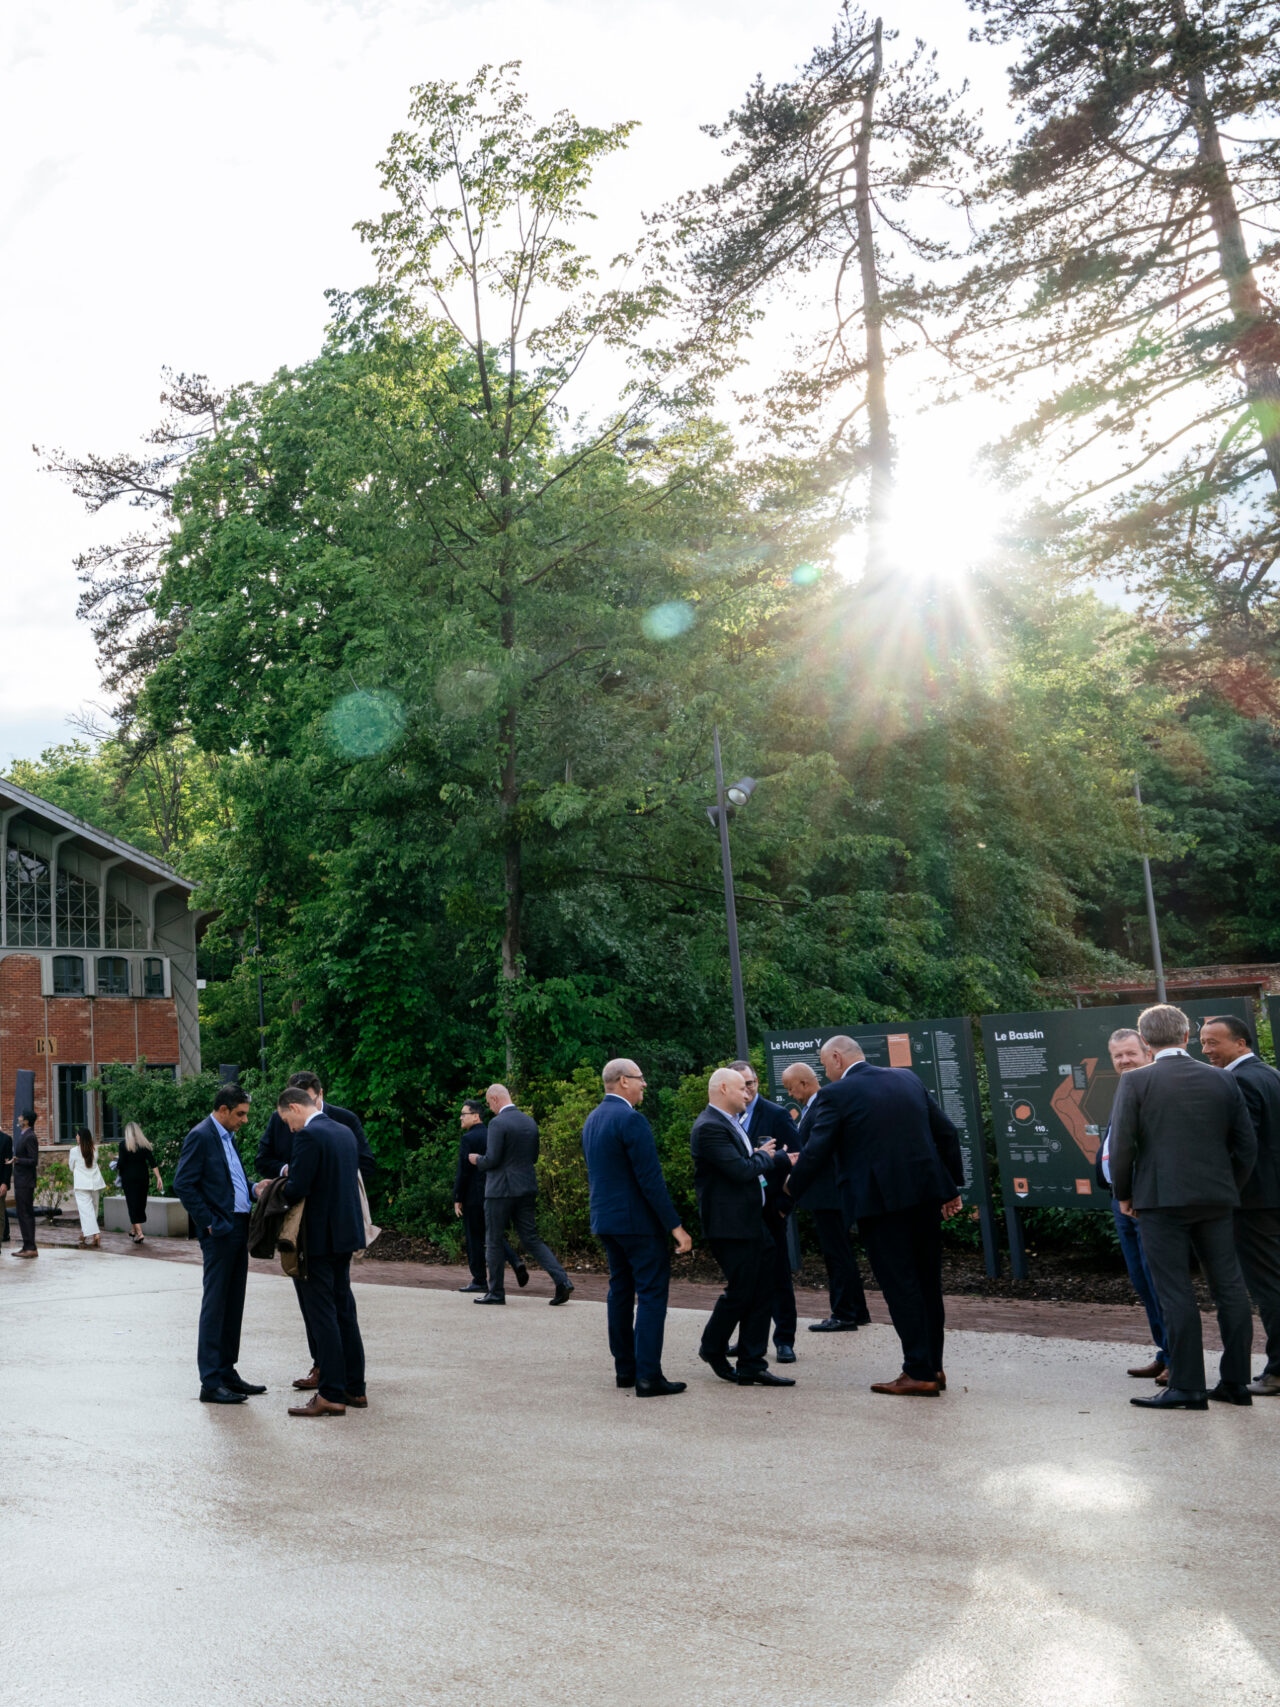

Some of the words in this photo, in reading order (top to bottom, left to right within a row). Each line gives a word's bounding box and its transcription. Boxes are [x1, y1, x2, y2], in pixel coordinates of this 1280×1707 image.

[994, 1031, 1007, 1041] Le
[1008, 1029, 1044, 1041] Bassin
[770, 1041, 781, 1050] Le
[781, 1040, 814, 1051] Hangar
[814, 1038, 822, 1047] Y
